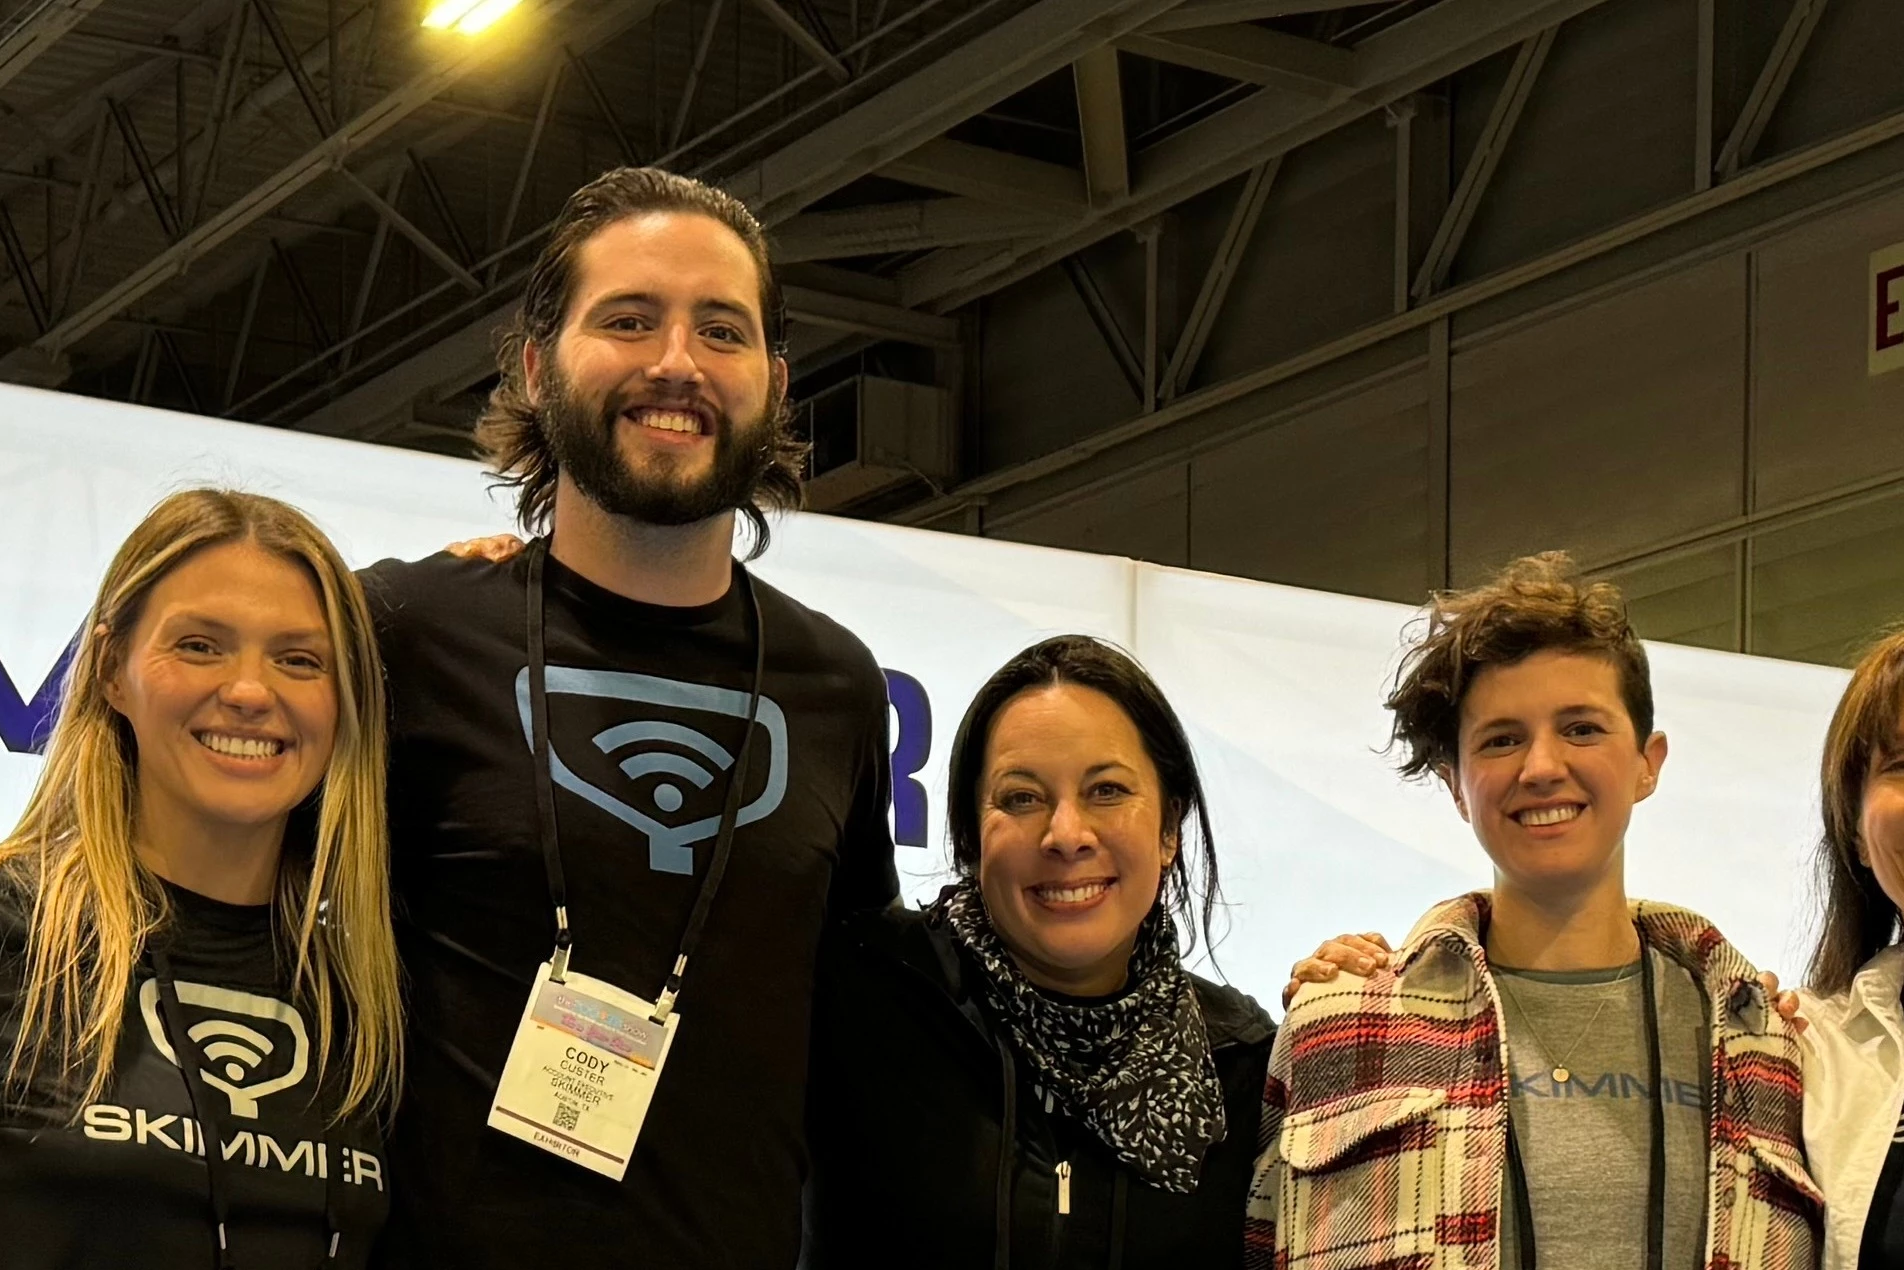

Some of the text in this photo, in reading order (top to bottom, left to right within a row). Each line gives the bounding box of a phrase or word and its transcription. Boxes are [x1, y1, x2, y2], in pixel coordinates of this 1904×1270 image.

[560, 1060, 606, 1086] CUSTER
[565, 1046, 610, 1074] CODY
[551, 1077, 601, 1106] SKIMMER
[83, 1104, 383, 1192] SKIMMER
[533, 1131, 581, 1158] EXHIBITOR
